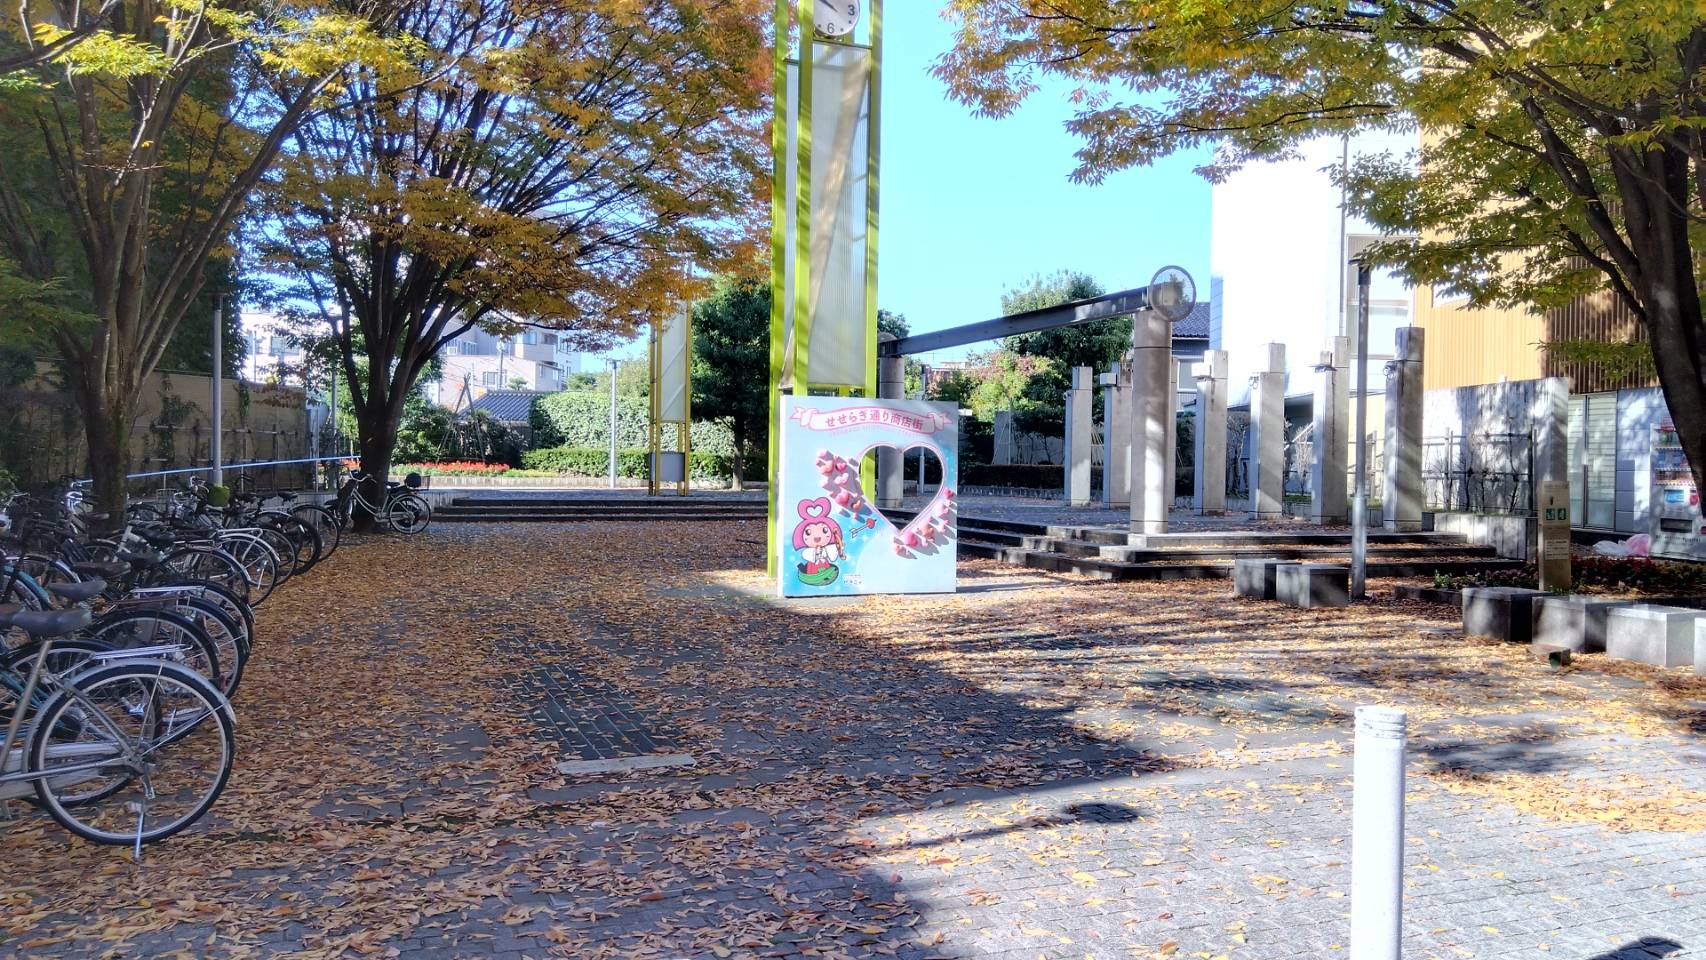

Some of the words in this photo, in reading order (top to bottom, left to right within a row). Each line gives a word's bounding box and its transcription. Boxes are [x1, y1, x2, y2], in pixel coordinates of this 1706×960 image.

[848, 4, 855, 16] 3
[827, 22, 835, 34] 6
[825, 410, 923, 431] せせらぎ通り商店街
